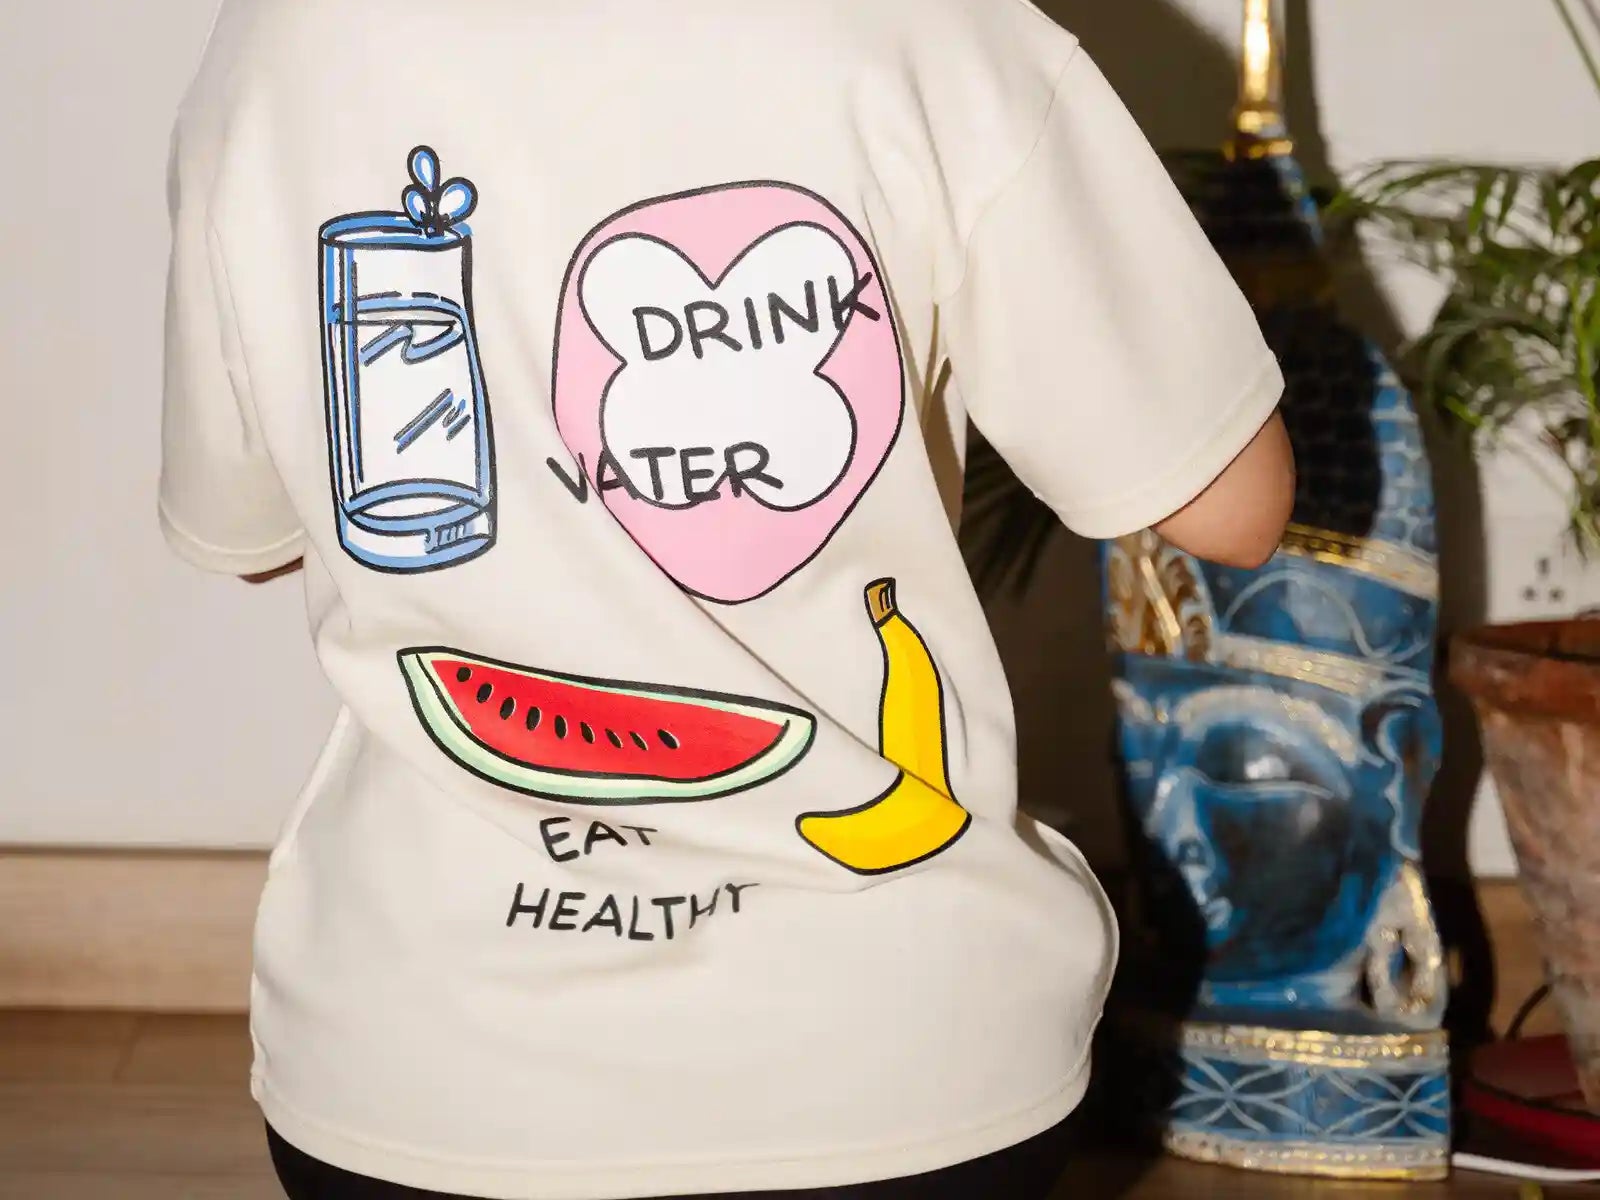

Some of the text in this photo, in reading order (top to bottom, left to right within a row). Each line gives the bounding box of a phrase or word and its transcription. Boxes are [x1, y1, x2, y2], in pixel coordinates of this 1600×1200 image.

[632, 272, 880, 361] DRINK
[539, 816, 658, 862] EAT
[506, 882, 760, 941] HEALTHY
